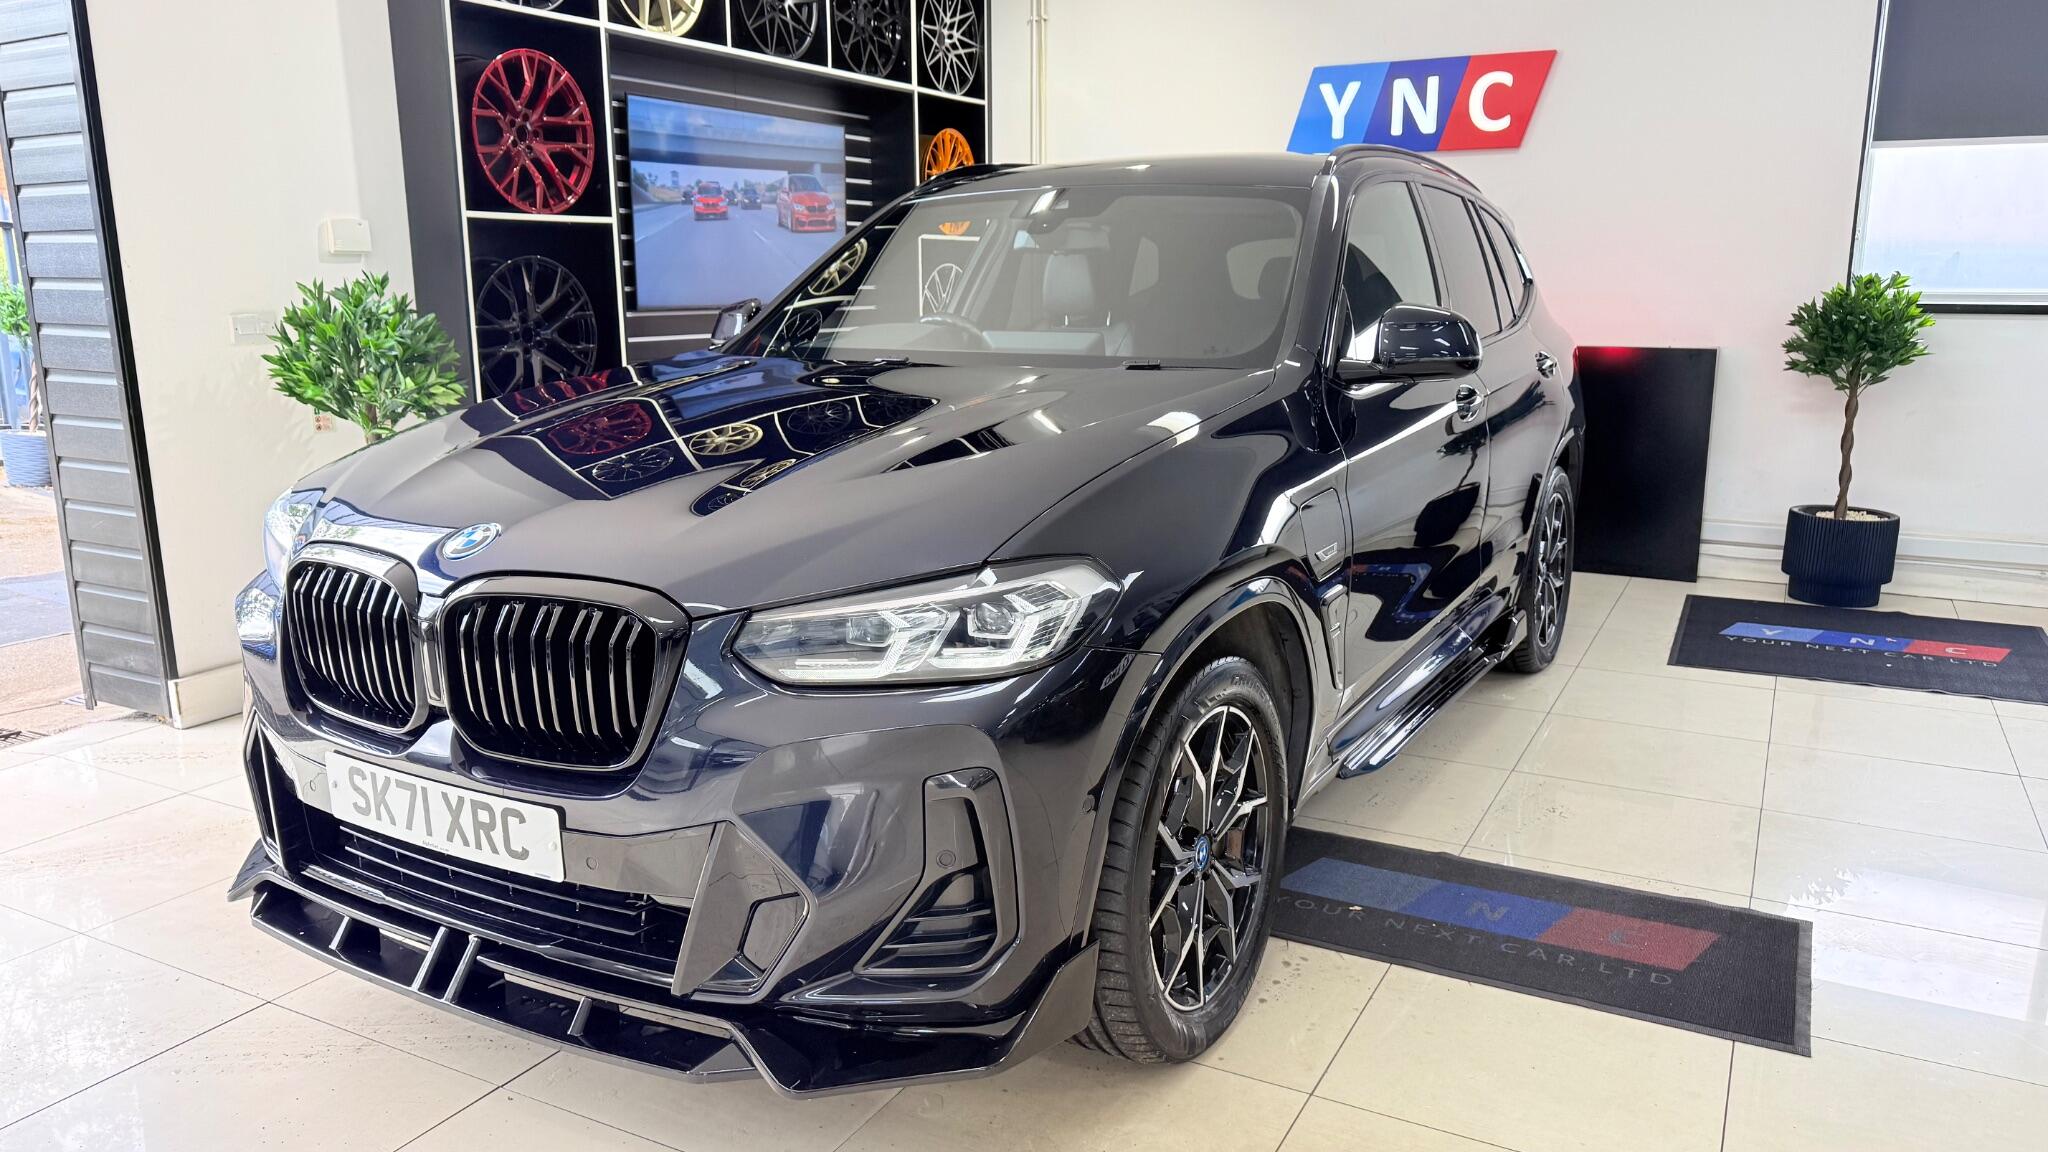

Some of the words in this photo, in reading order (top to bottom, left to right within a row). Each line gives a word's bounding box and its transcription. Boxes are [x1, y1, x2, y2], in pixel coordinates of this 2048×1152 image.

[1318, 70, 1515, 140] YNC
[1726, 635, 1792, 647] YOUR
[1805, 642, 1870, 654] NEXT
[1884, 651, 1934, 662] CAR
[1949, 657, 1998, 667] LTD
[348, 766, 433, 837] SK71
[441, 791, 530, 861] XRC
[1384, 917, 1482, 945] NEXT
[1599, 960, 1673, 986] LTD
